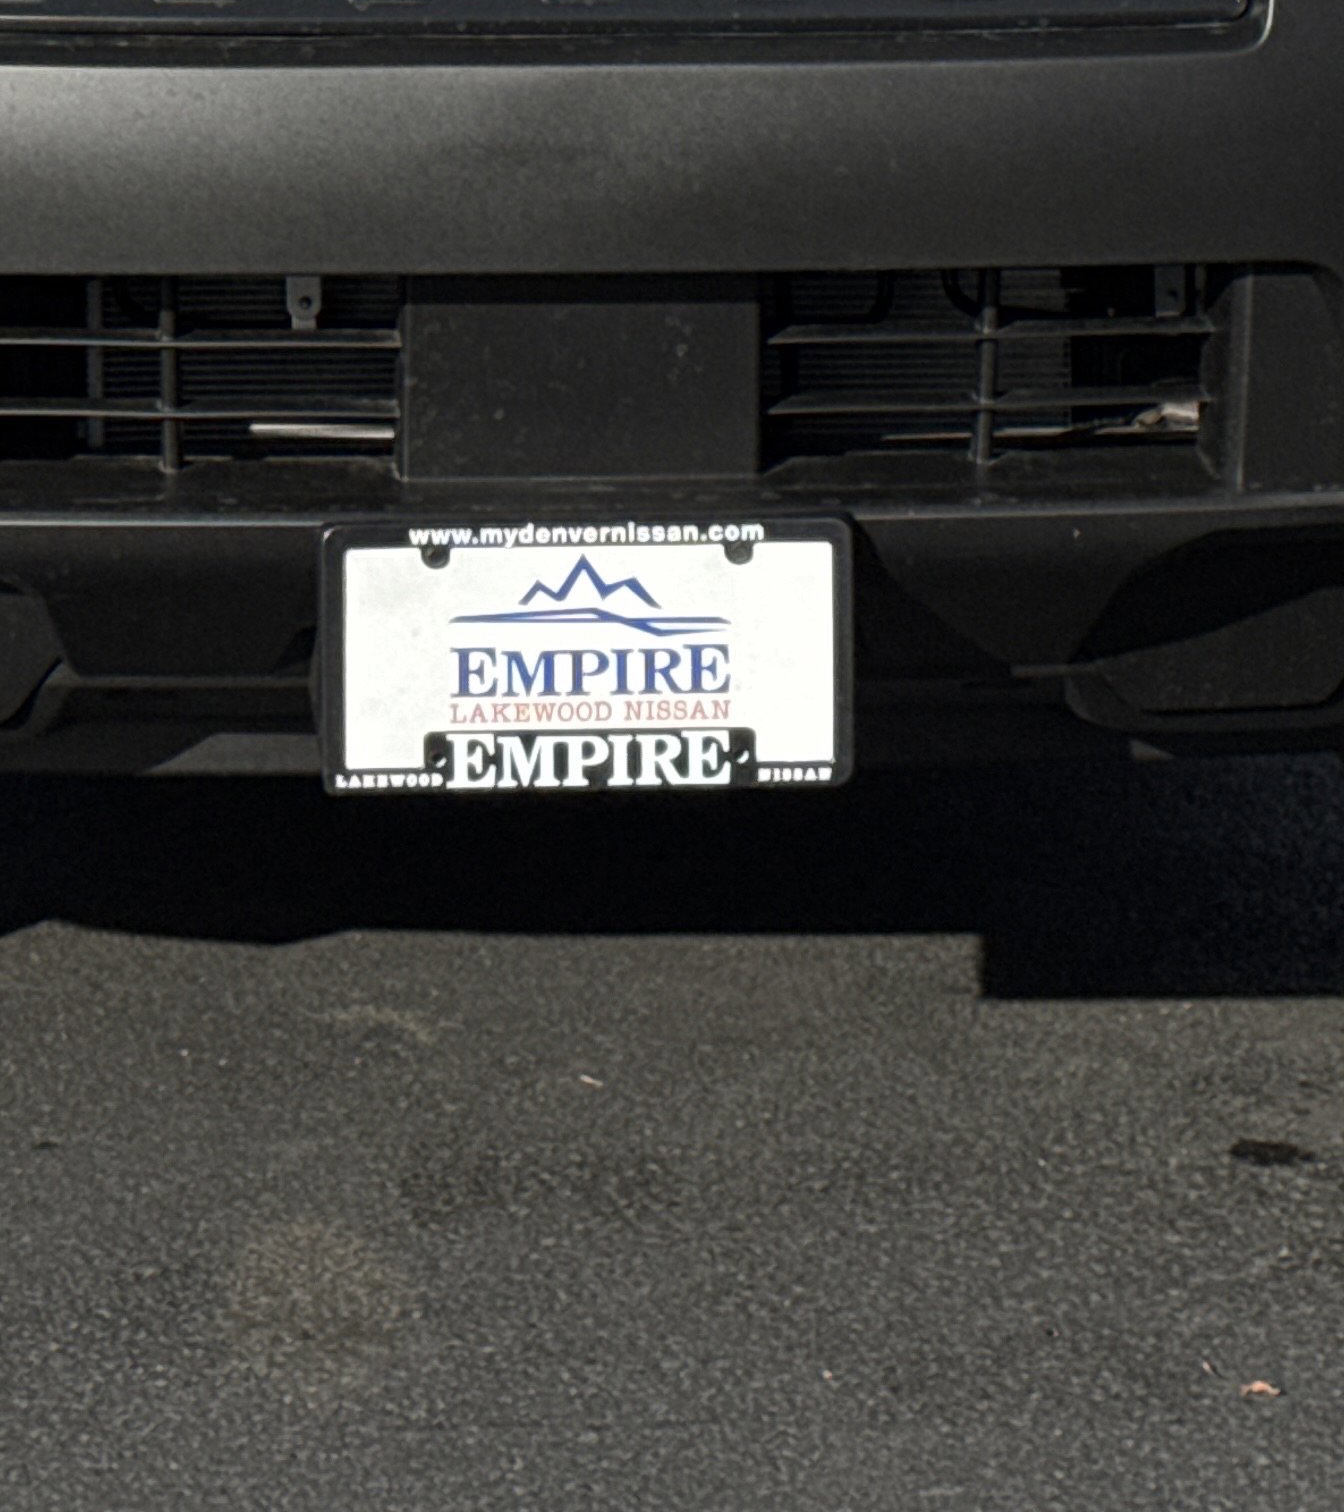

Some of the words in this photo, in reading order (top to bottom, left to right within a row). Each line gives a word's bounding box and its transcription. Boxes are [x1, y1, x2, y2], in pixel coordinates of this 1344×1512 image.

[408, 522, 765, 548] www.mydenvernissan.com
[449, 643, 732, 698] EMPIRE
[450, 701, 613, 724] LAKEWOOD
[623, 698, 732, 721] NISSAN
[445, 729, 732, 789] EMPIRE
